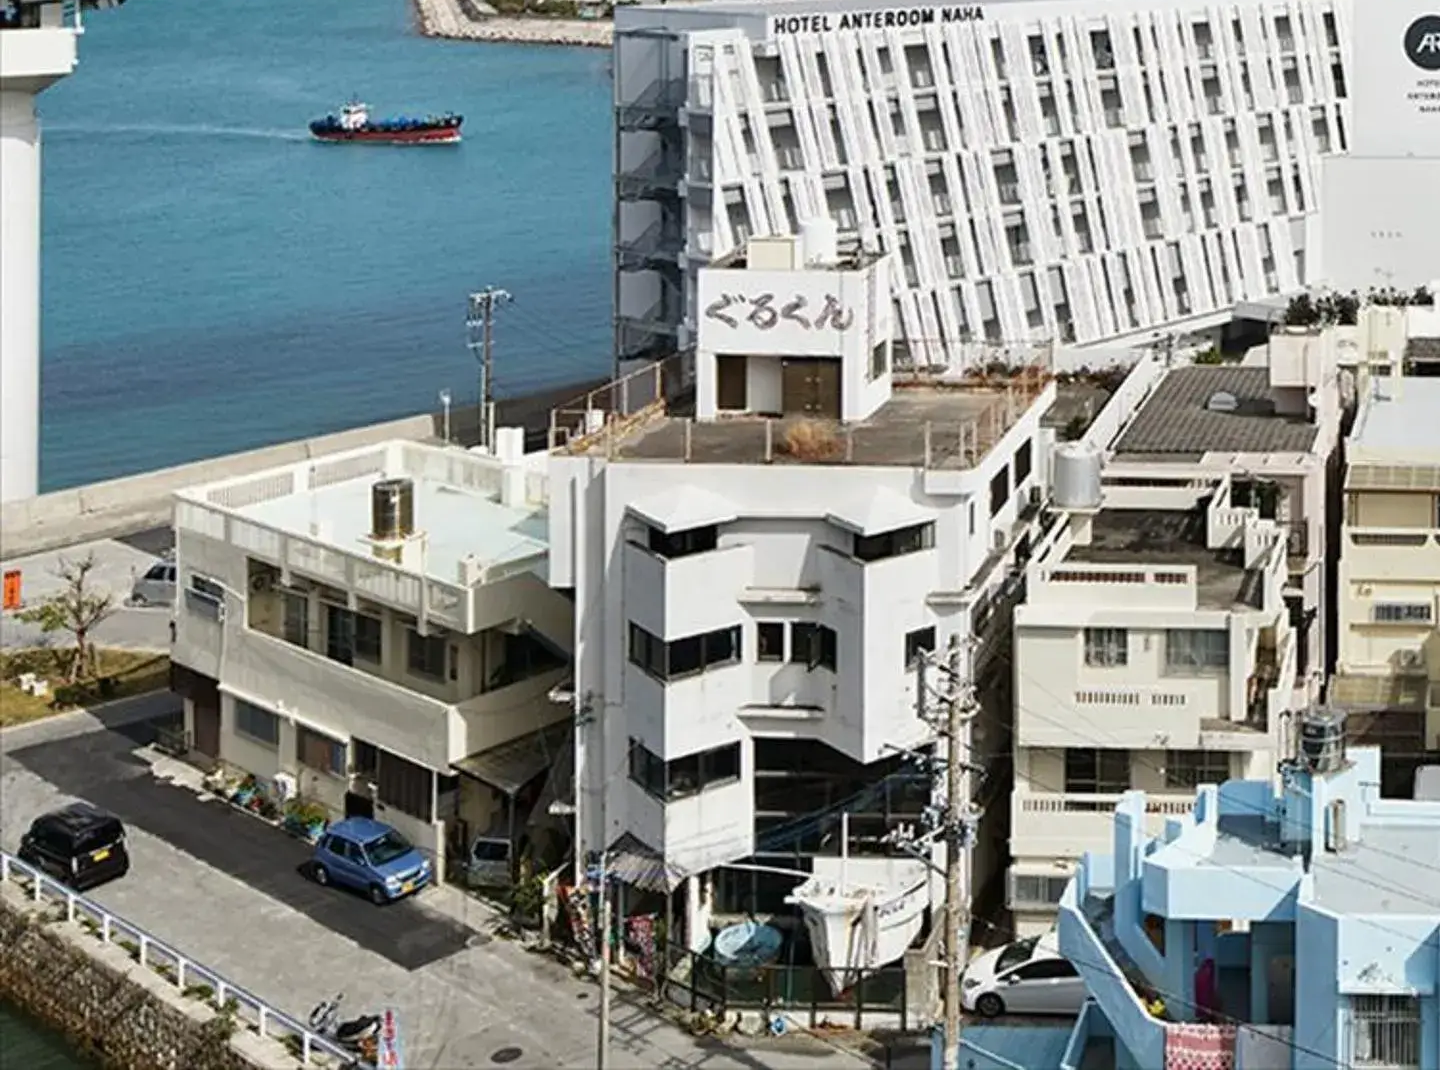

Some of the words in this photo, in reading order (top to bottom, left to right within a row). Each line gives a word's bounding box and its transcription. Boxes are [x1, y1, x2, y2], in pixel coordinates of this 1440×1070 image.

[774, 15, 832, 34] HOTEL
[839, 8, 935, 29] ANTEROOM
[941, 6, 984, 23] NAHA
[705, 293, 854, 330] ぐるくん
